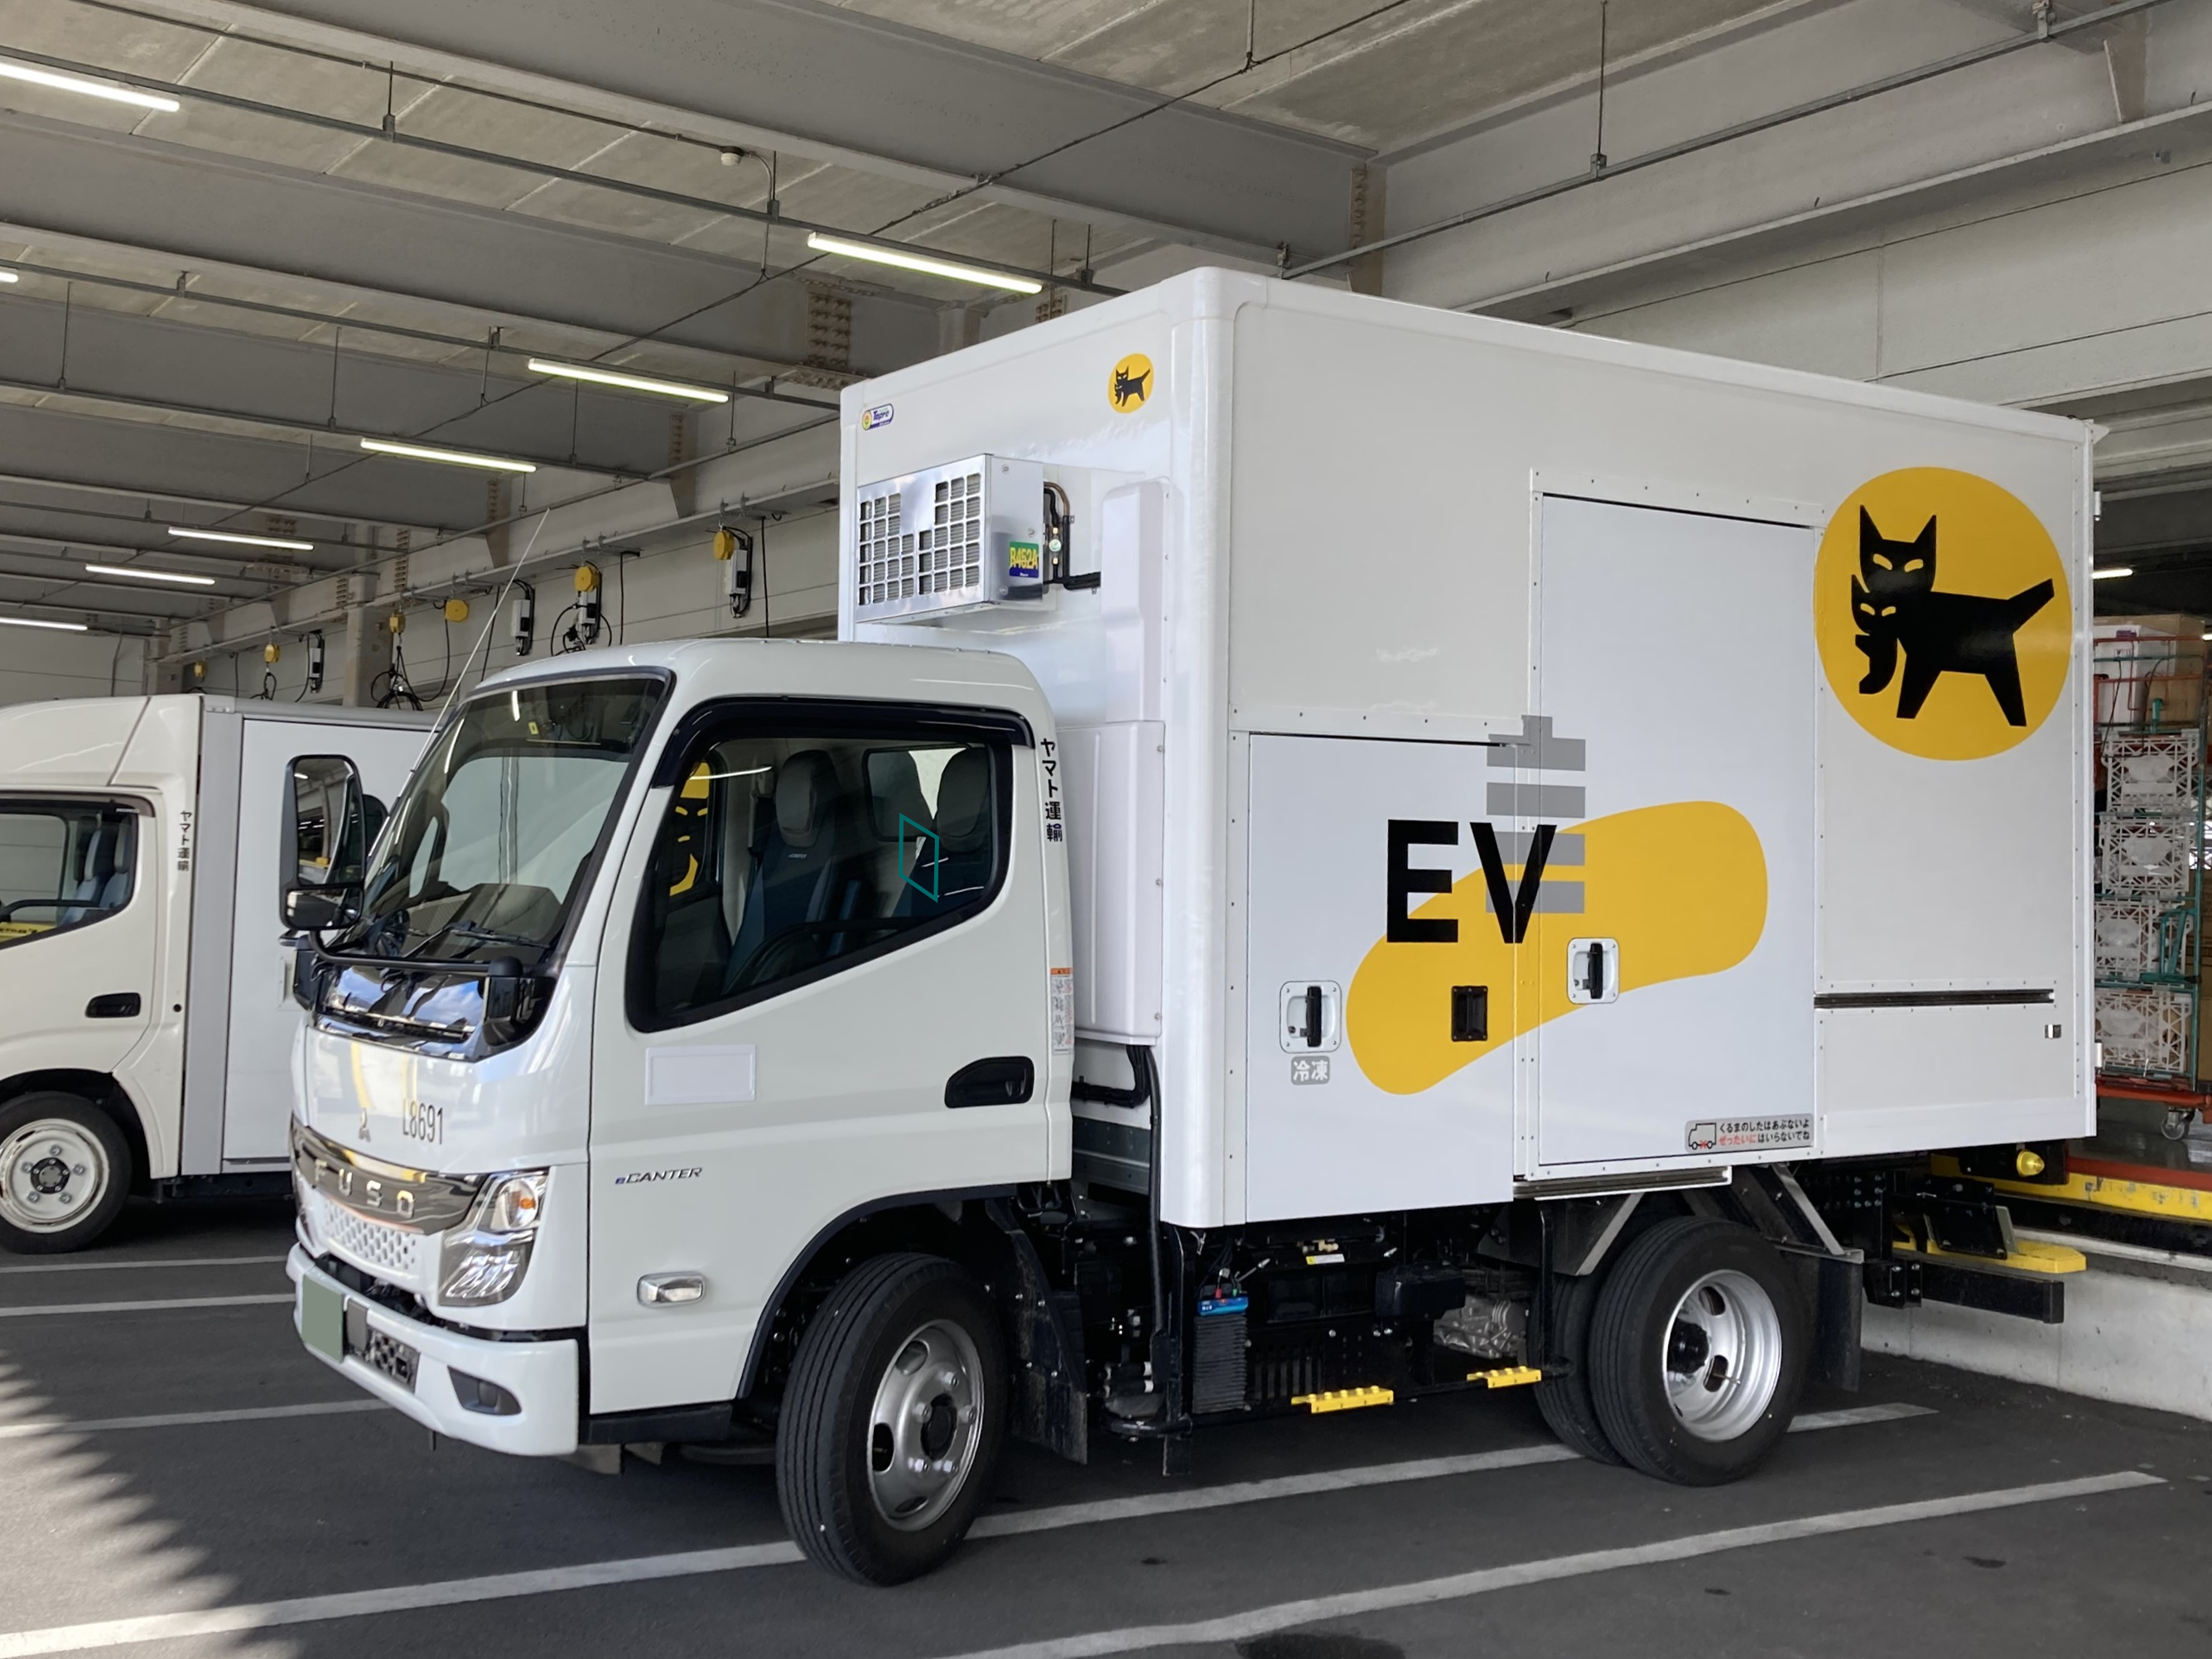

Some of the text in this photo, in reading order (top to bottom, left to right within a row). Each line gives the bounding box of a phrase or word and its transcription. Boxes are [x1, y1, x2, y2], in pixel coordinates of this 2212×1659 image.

[1040, 738, 1063, 842] ヤマト運輸
[1387, 819, 1558, 943] EV
[1293, 1059, 1328, 1082] 冷凍
[402, 1097, 443, 1145] L8691
[1720, 1119, 1810, 1133] くるまのしたはあぶないよ
[315, 1159, 414, 1219] FUSO
[614, 1167, 702, 1184] eCANTER
